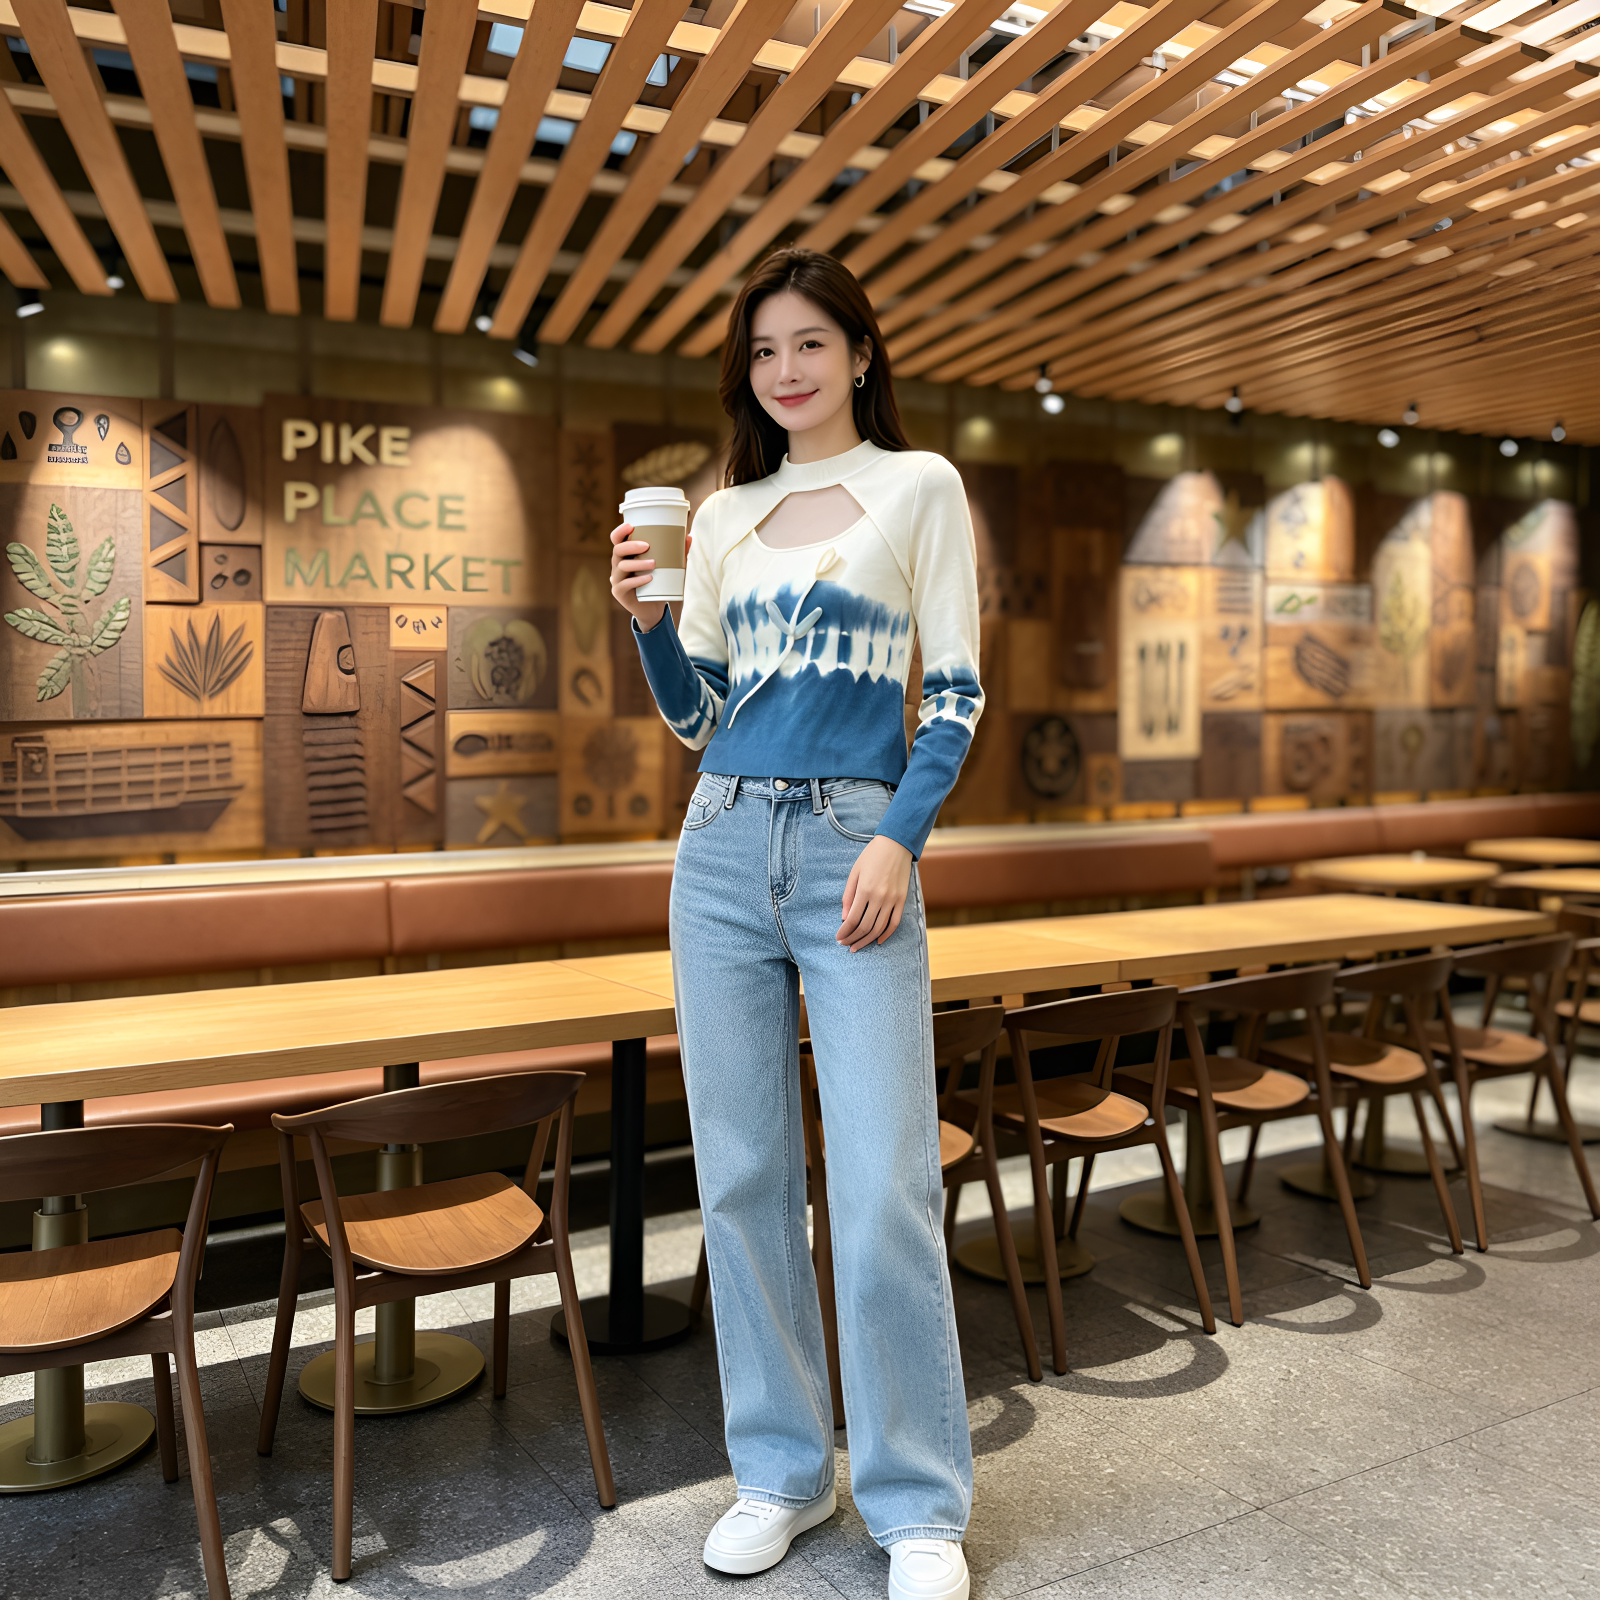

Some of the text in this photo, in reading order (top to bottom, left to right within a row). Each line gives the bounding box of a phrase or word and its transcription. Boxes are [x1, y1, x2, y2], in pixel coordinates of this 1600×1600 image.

[282, 419, 411, 466] PIKE
[283, 481, 467, 531] PLACE
[285, 548, 523, 594] MARKET
